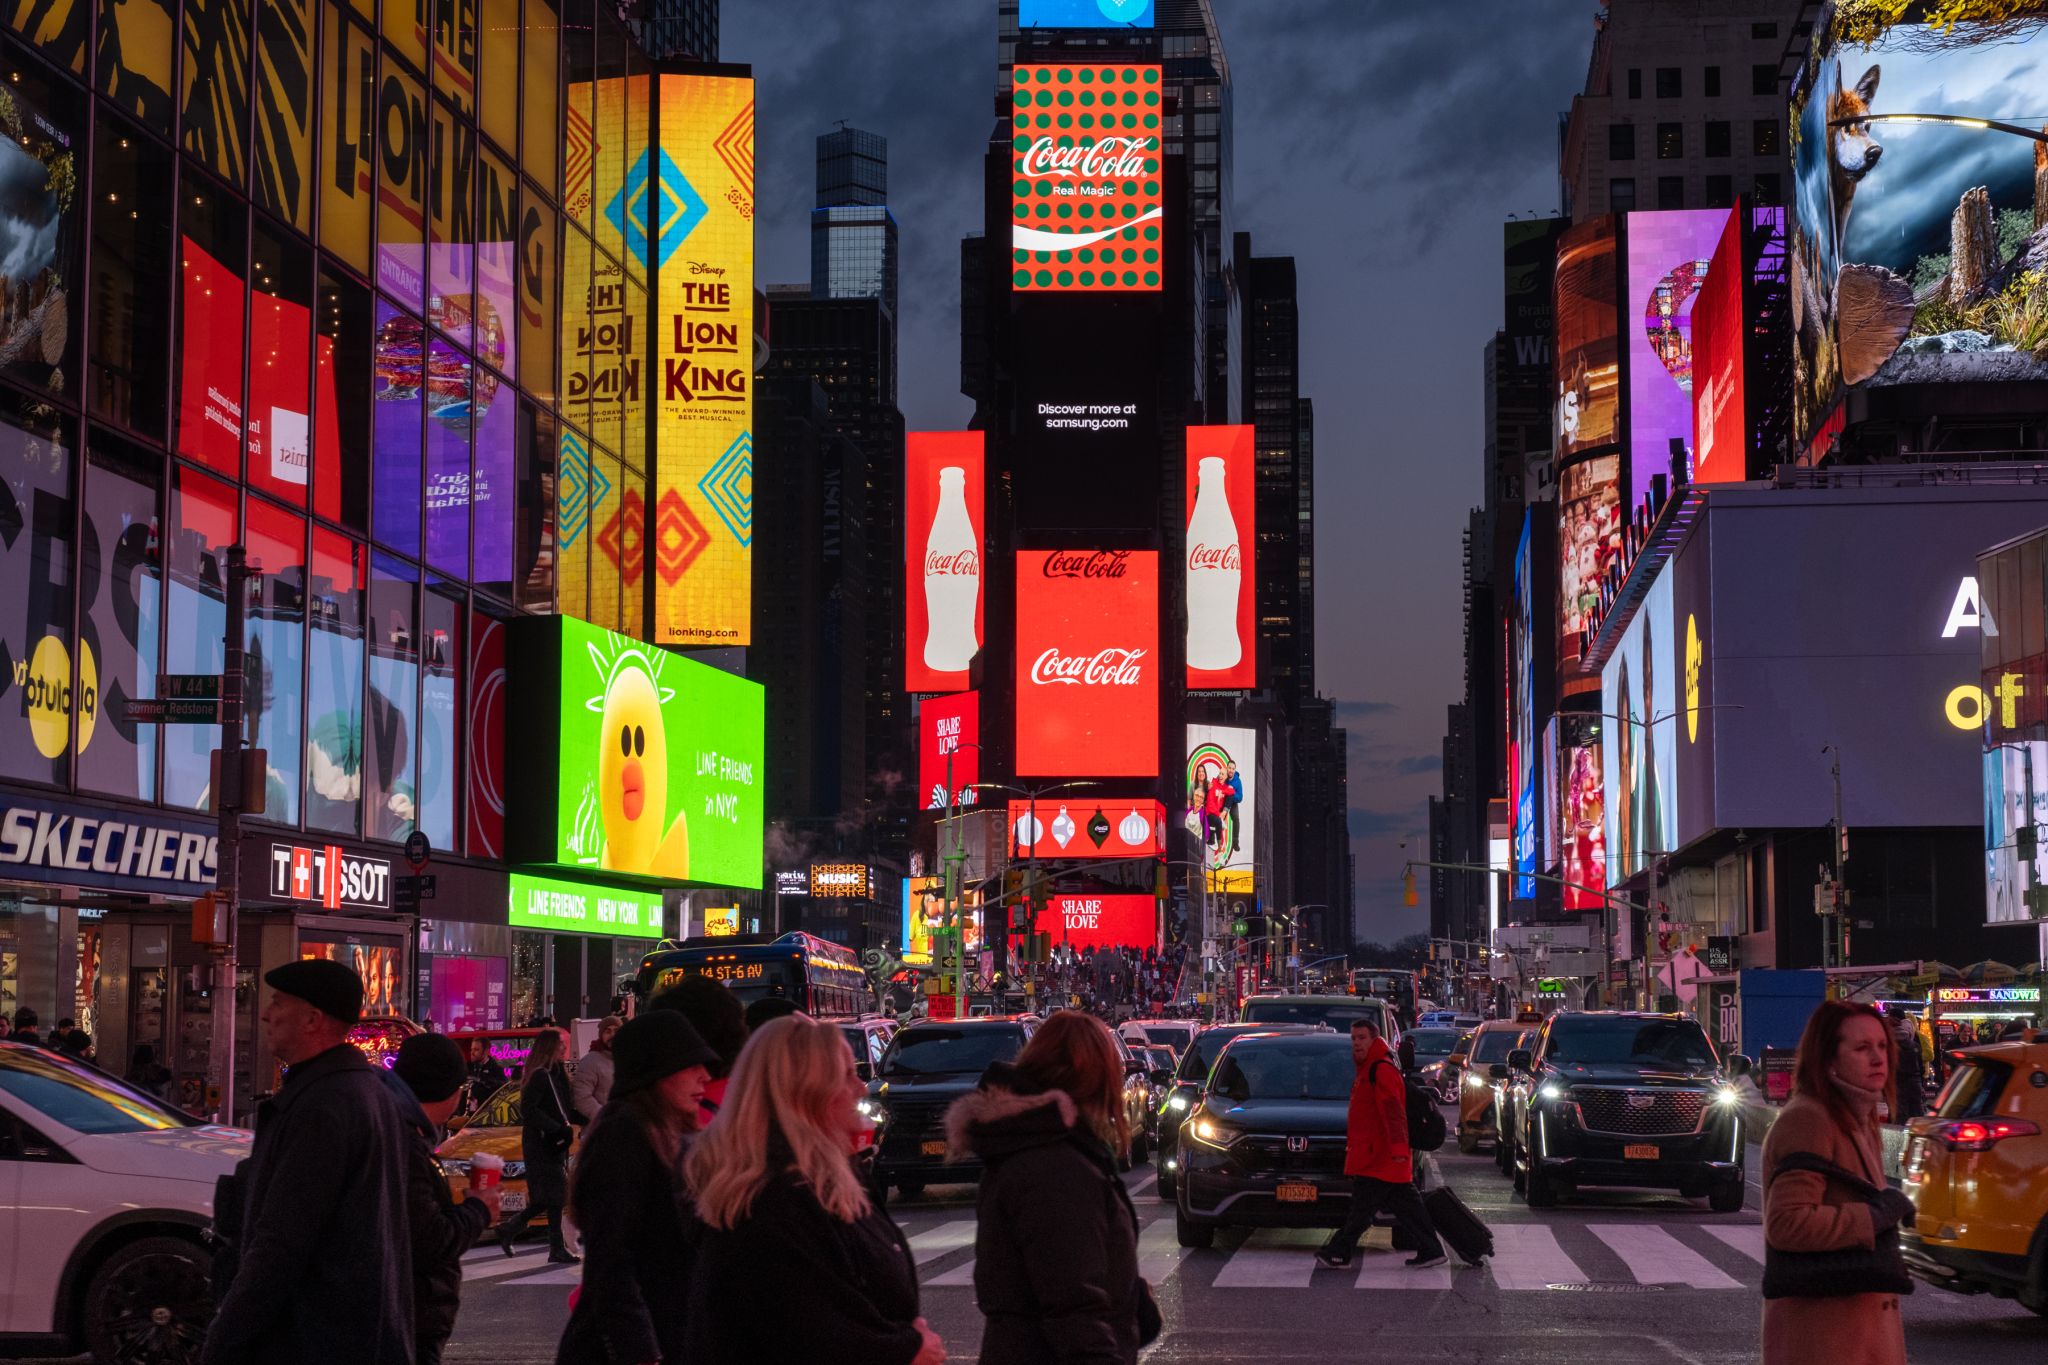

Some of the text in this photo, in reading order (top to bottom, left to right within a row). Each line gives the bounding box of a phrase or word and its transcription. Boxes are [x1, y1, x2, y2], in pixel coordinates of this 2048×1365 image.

[1022, 136, 1153, 178] Coca-Cola
[1053, 186, 1114, 197] Real Magic
[381, 255, 421, 298] ENTRANCE
[687, 261, 725, 279] Disney
[682, 283, 730, 305] THE
[674, 315, 738, 354] LION
[665, 359, 746, 403] KING
[1038, 403, 1136, 414] Discover more at
[1046, 418, 1128, 431] samsung.com
[1043, 551, 1131, 579] Coca-Cola
[1941, 577, 2000, 637] A
[669, 627, 739, 638] lionking.com
[1031, 648, 1148, 686] Coca-Cola
[173, 678, 182, 695] W
[186, 678, 203, 695] 44
[170, 702, 213, 714] Redstone
[1944, 671, 2024, 730] of
[937, 716, 960, 737] SHARE
[939, 736, 958, 755] LOVE
[696, 751, 753, 785] LINE FRIENDS
[705, 793, 737, 824] in NYC
[818, 873, 859, 885] MUSIC
[528, 889, 550, 915] LINE
[551, 891, 586, 920] FRIENDS
[597, 898, 617, 922] NEW
[618, 900, 639, 925] YORK
[1062, 900, 1101, 914] SHARE
[1065, 915, 1098, 929] LOVE
[716, 966, 744, 979] ST-6
[747, 964, 763, 978] AV
